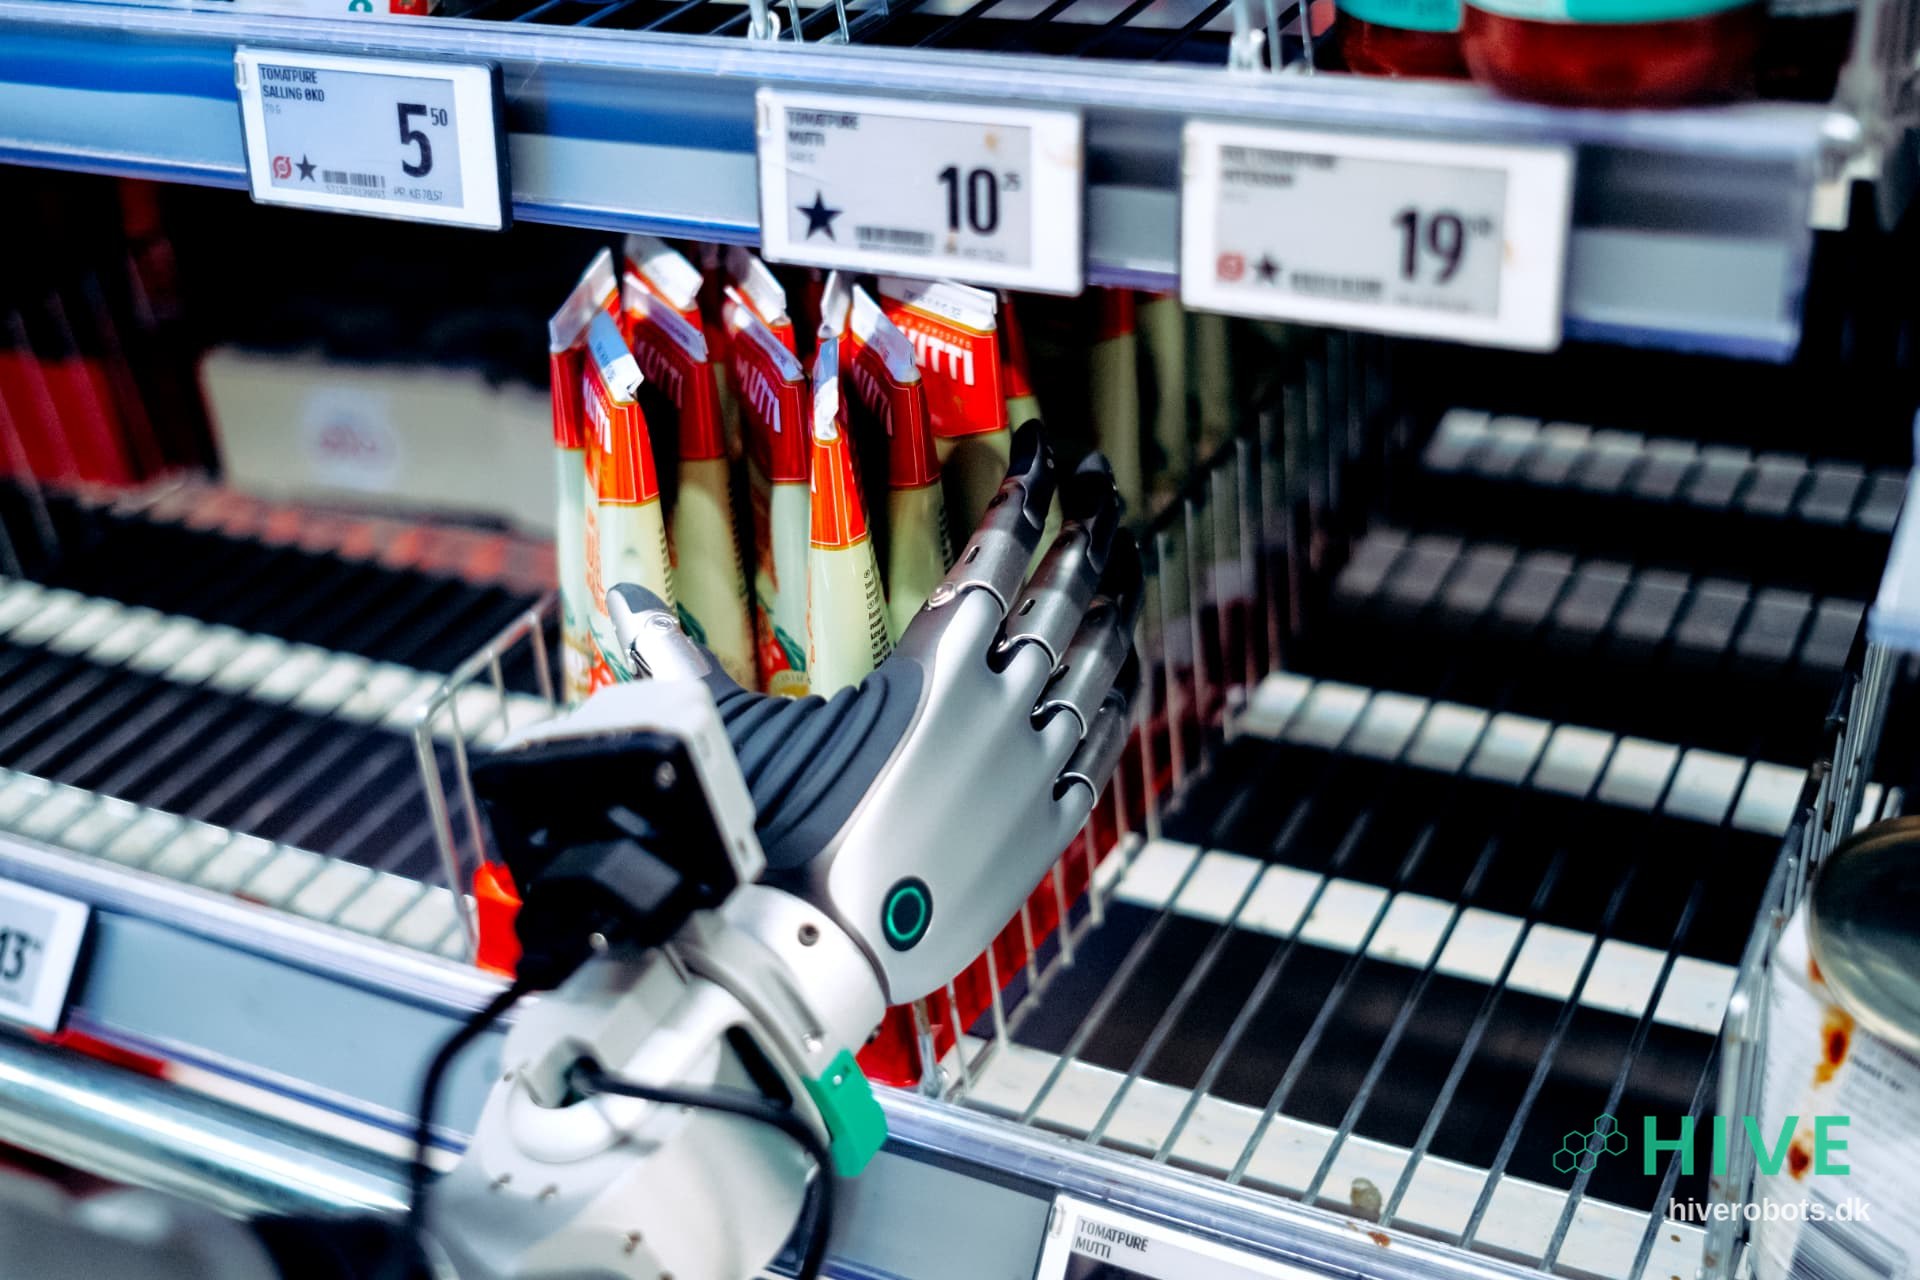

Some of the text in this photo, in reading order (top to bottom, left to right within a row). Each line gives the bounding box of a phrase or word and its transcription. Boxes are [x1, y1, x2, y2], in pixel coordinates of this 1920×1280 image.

[260, 67, 318, 84] TOMATPURE
[262, 85, 325, 102] SALLING ØKO
[396, 102, 448, 178] 5 50
[788, 131, 825, 147] MUTTI
[937, 164, 1000, 237] 10
[1390, 207, 1465, 286] 19
[897, 325, 975, 386] UTTI
[735, 353, 782, 433] MUTTI
[1075, 1236, 1112, 1259] MUTTI
[1080, 1219, 1149, 1252] TOMATPURE
